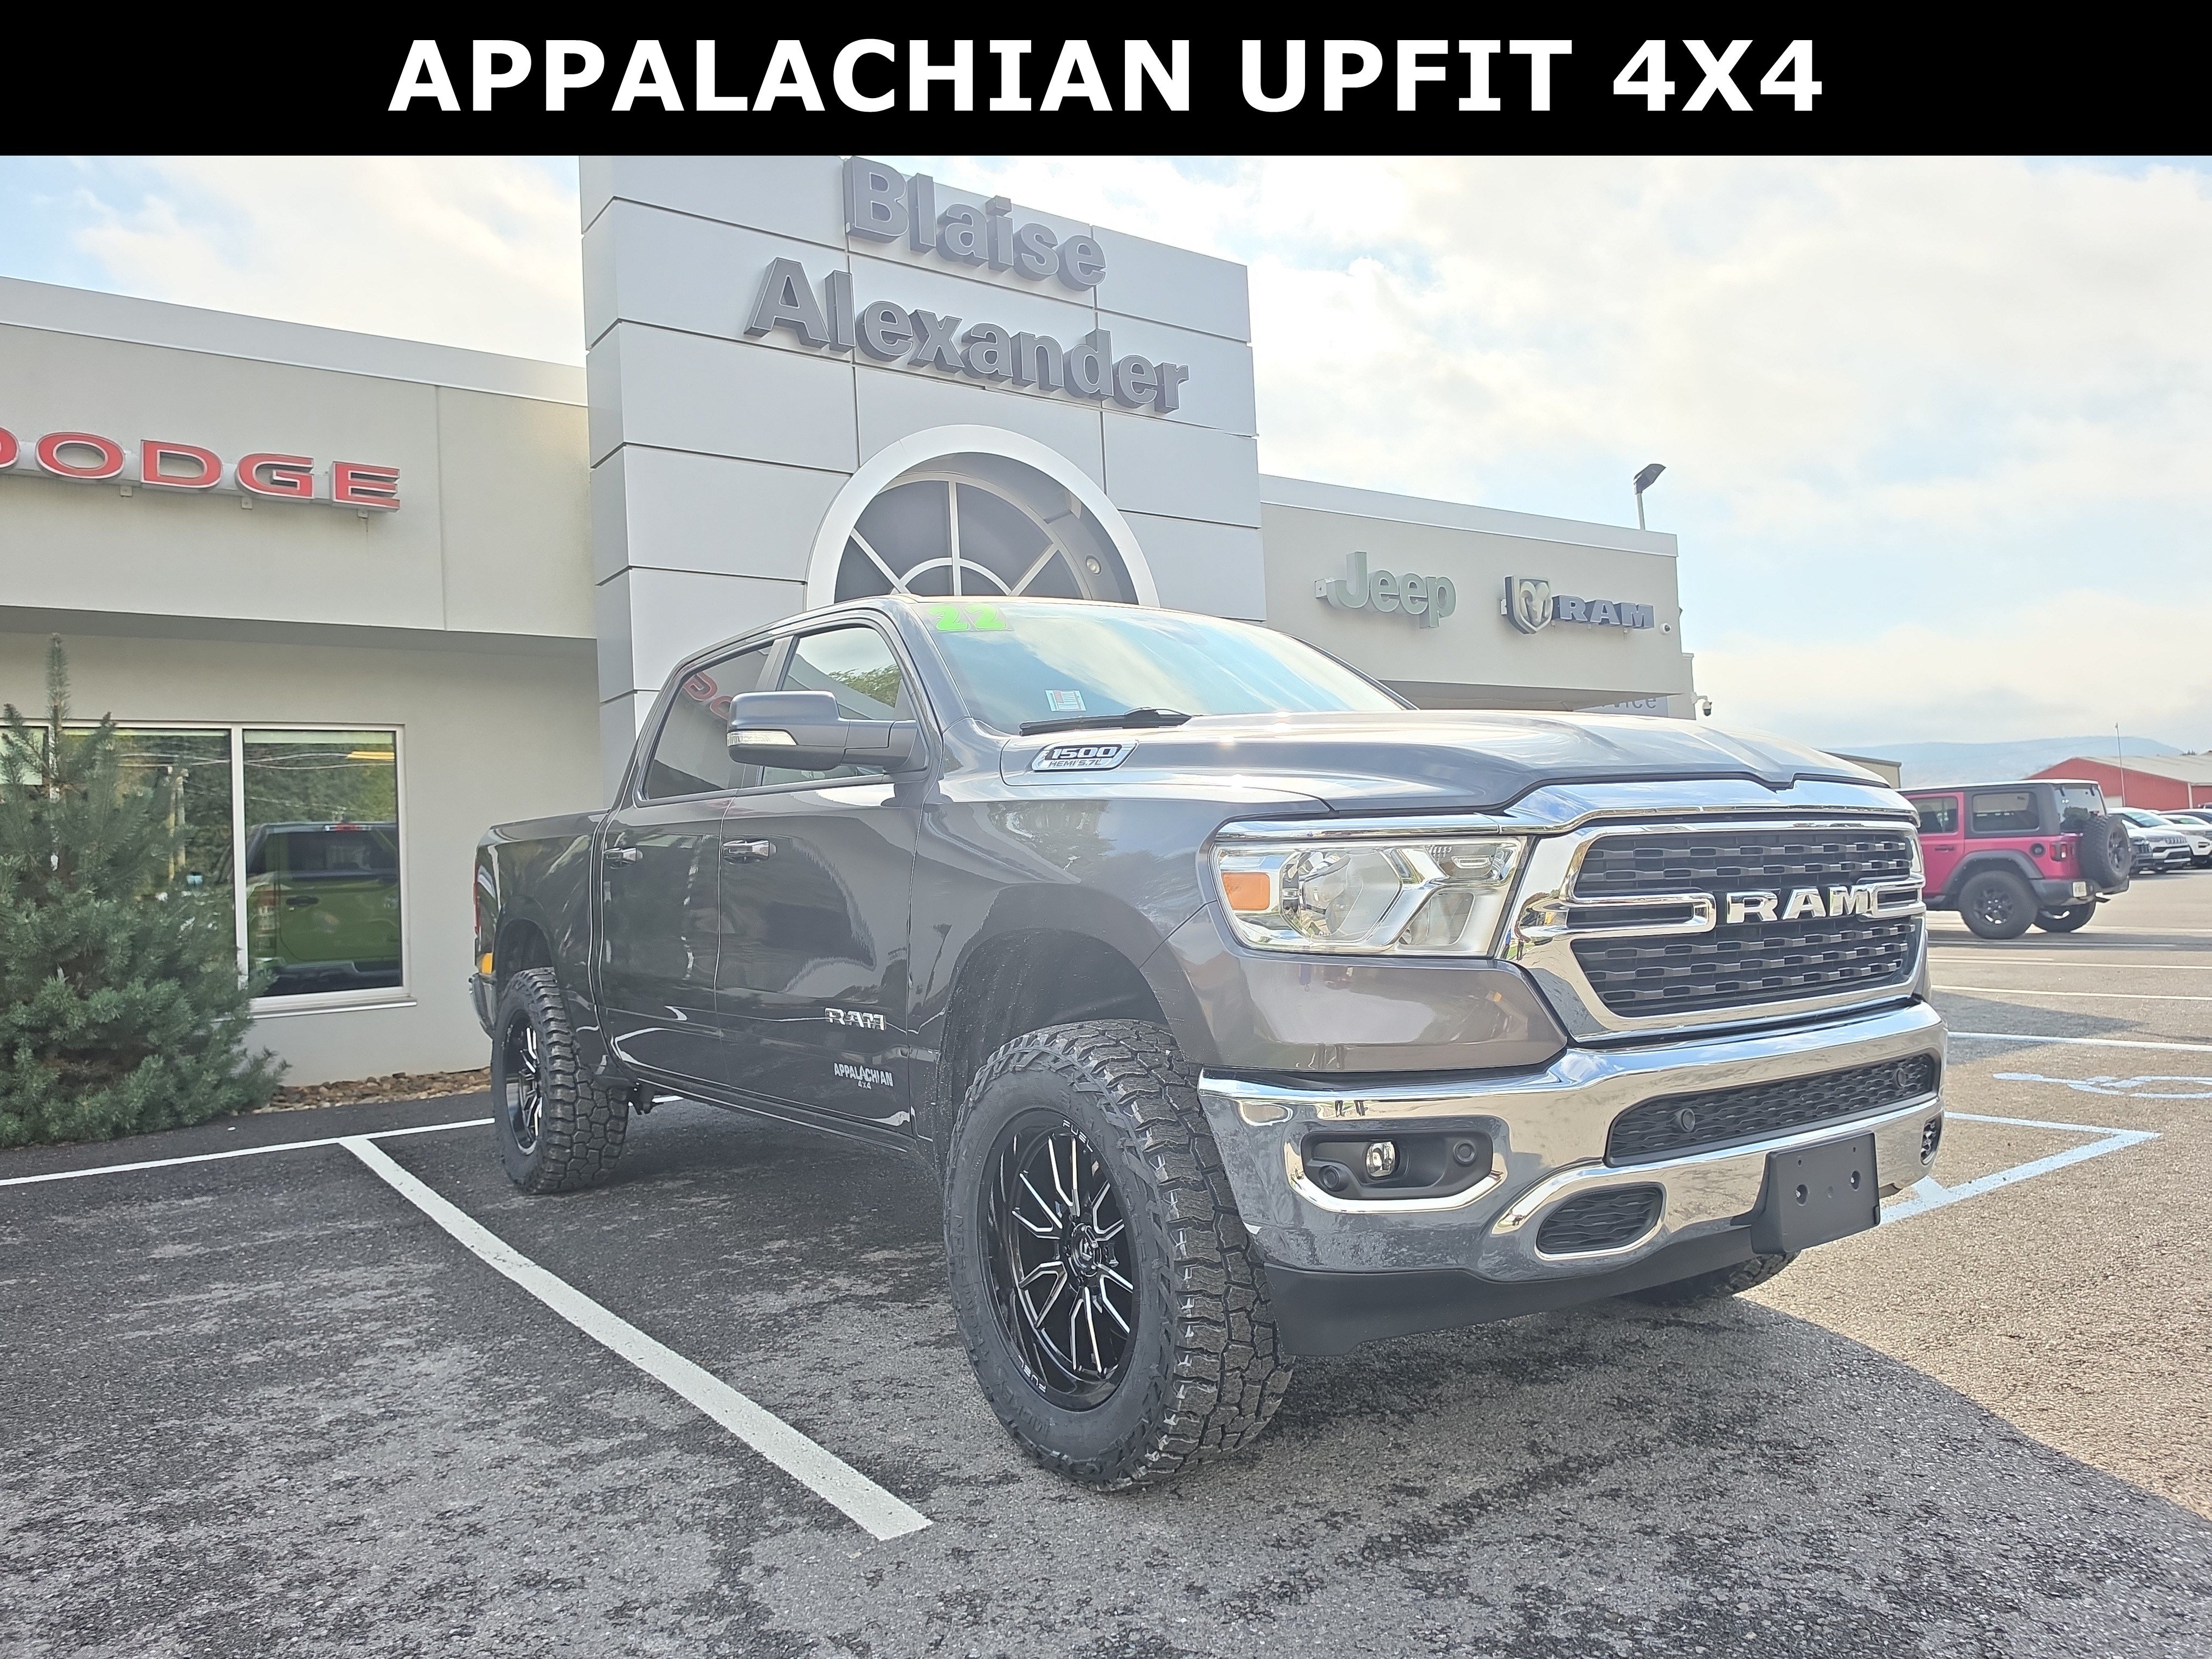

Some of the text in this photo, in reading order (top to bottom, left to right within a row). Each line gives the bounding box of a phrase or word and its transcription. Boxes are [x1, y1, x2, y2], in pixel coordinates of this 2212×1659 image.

[845, 156, 1106, 291] Blaise
[744, 257, 1189, 413] Alexander
[0, 425, 401, 512] ODGE
[1323, 551, 1456, 628] Jeep
[927, 604, 1007, 632] 22
[1553, 595, 1654, 629] RAM
[1052, 747, 1118, 759] 1500
[1726, 885, 1873, 923] RAM
[825, 1007, 886, 1031] RAM
[833, 1062, 893, 1087] APPALACHIAN
[1063, 1119, 1094, 1153] FUEL
[1018, 1354, 1047, 1393] FUEL
